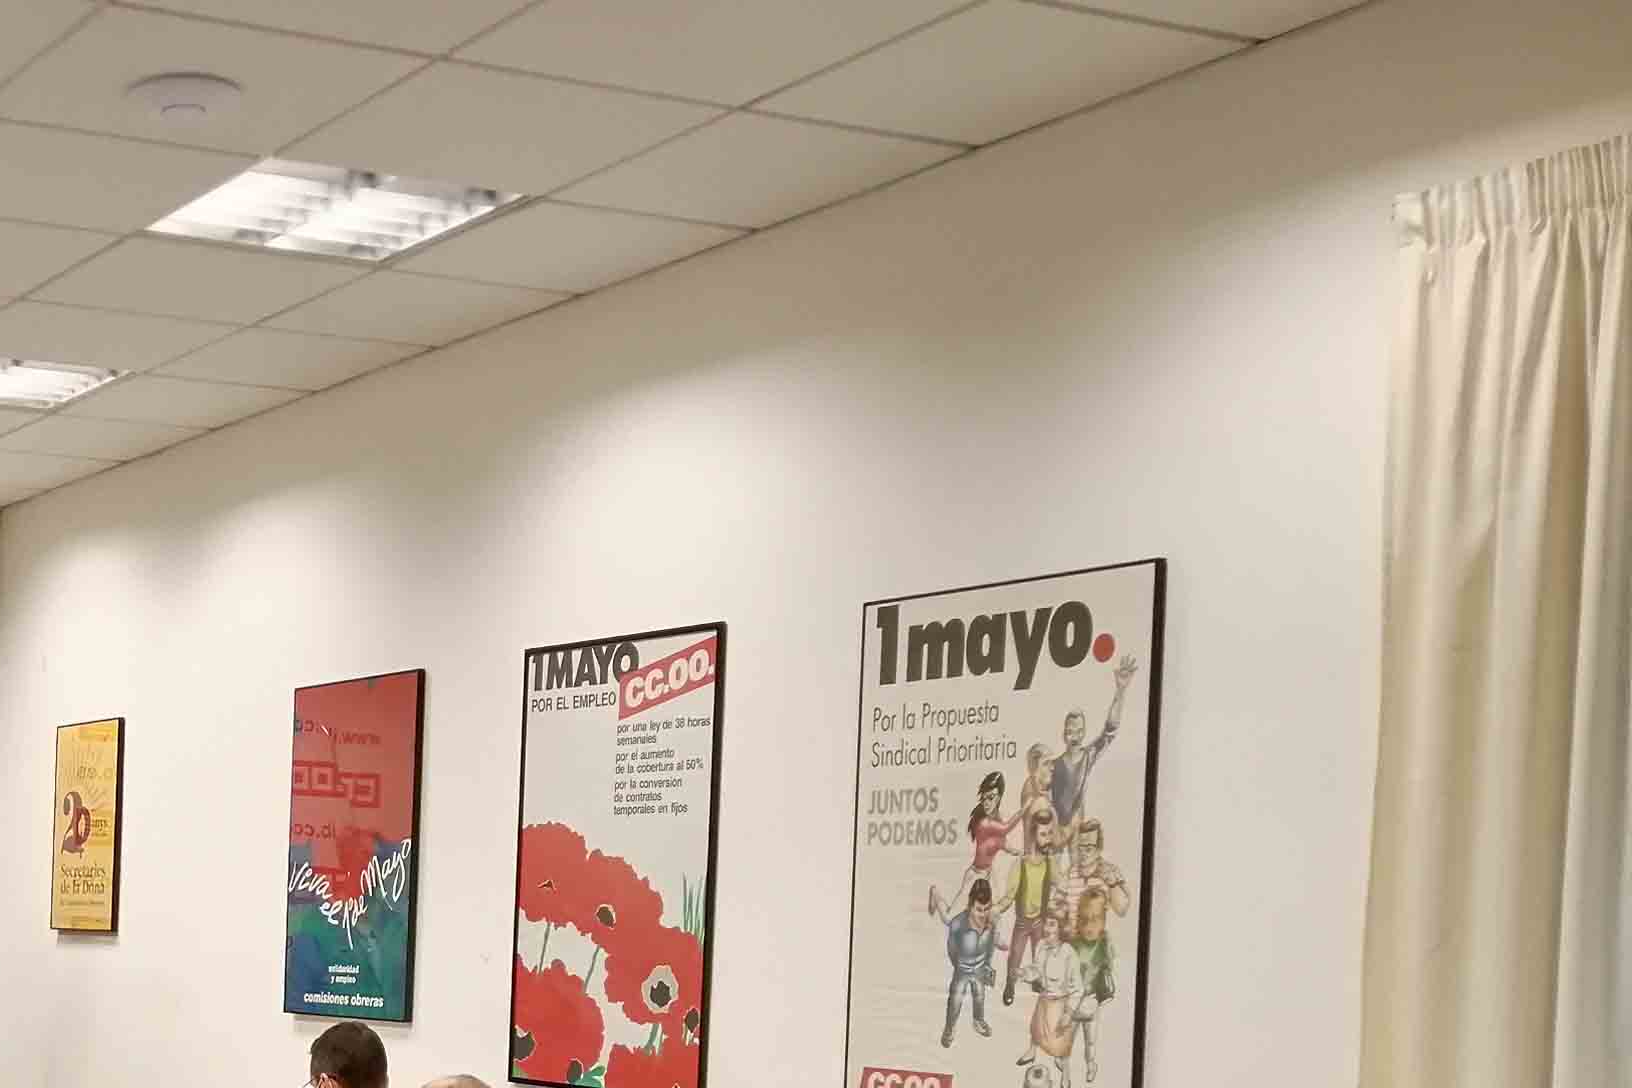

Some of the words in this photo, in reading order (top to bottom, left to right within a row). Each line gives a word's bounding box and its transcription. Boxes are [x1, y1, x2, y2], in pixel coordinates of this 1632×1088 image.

[532, 697, 553, 713] POR
[556, 696, 570, 710] EL
[573, 691, 617, 710] EMPLEO
[617, 724, 630, 736] por
[633, 723, 647, 732] una
[650, 721, 661, 734] ley
[662, 720, 673, 730] de
[675, 718, 685, 729] 38
[687, 717, 712, 728] horas
[873, 706, 896, 733] Por
[902, 704, 916, 730] la
[921, 700, 999, 734] Propuesta
[615, 753, 628, 765] por
[631, 749, 638, 761] el
[640, 750, 675, 760] aumento
[871, 738, 931, 768] Sindical
[937, 735, 1017, 763] Prioritaria
[615, 765, 625, 775] de
[627, 764, 634, 773] la
[637, 762, 674, 773] cobertura
[676, 760, 684, 770] al
[614, 782, 627, 793] por
[630, 779, 637, 789] la
[614, 793, 623, 803] de
[868, 787, 939, 815] JUNTOS
[613, 803, 656, 816] temporales
[658, 805, 668, 814] en
[671, 802, 689, 816] fijos
[867, 818, 958, 846] PODEMOS
[288, 861, 333, 899] Viva
[360, 838, 412, 911] Mayo
[303, 992, 349, 1005] comisiones
[350, 993, 385, 1008] obreras
